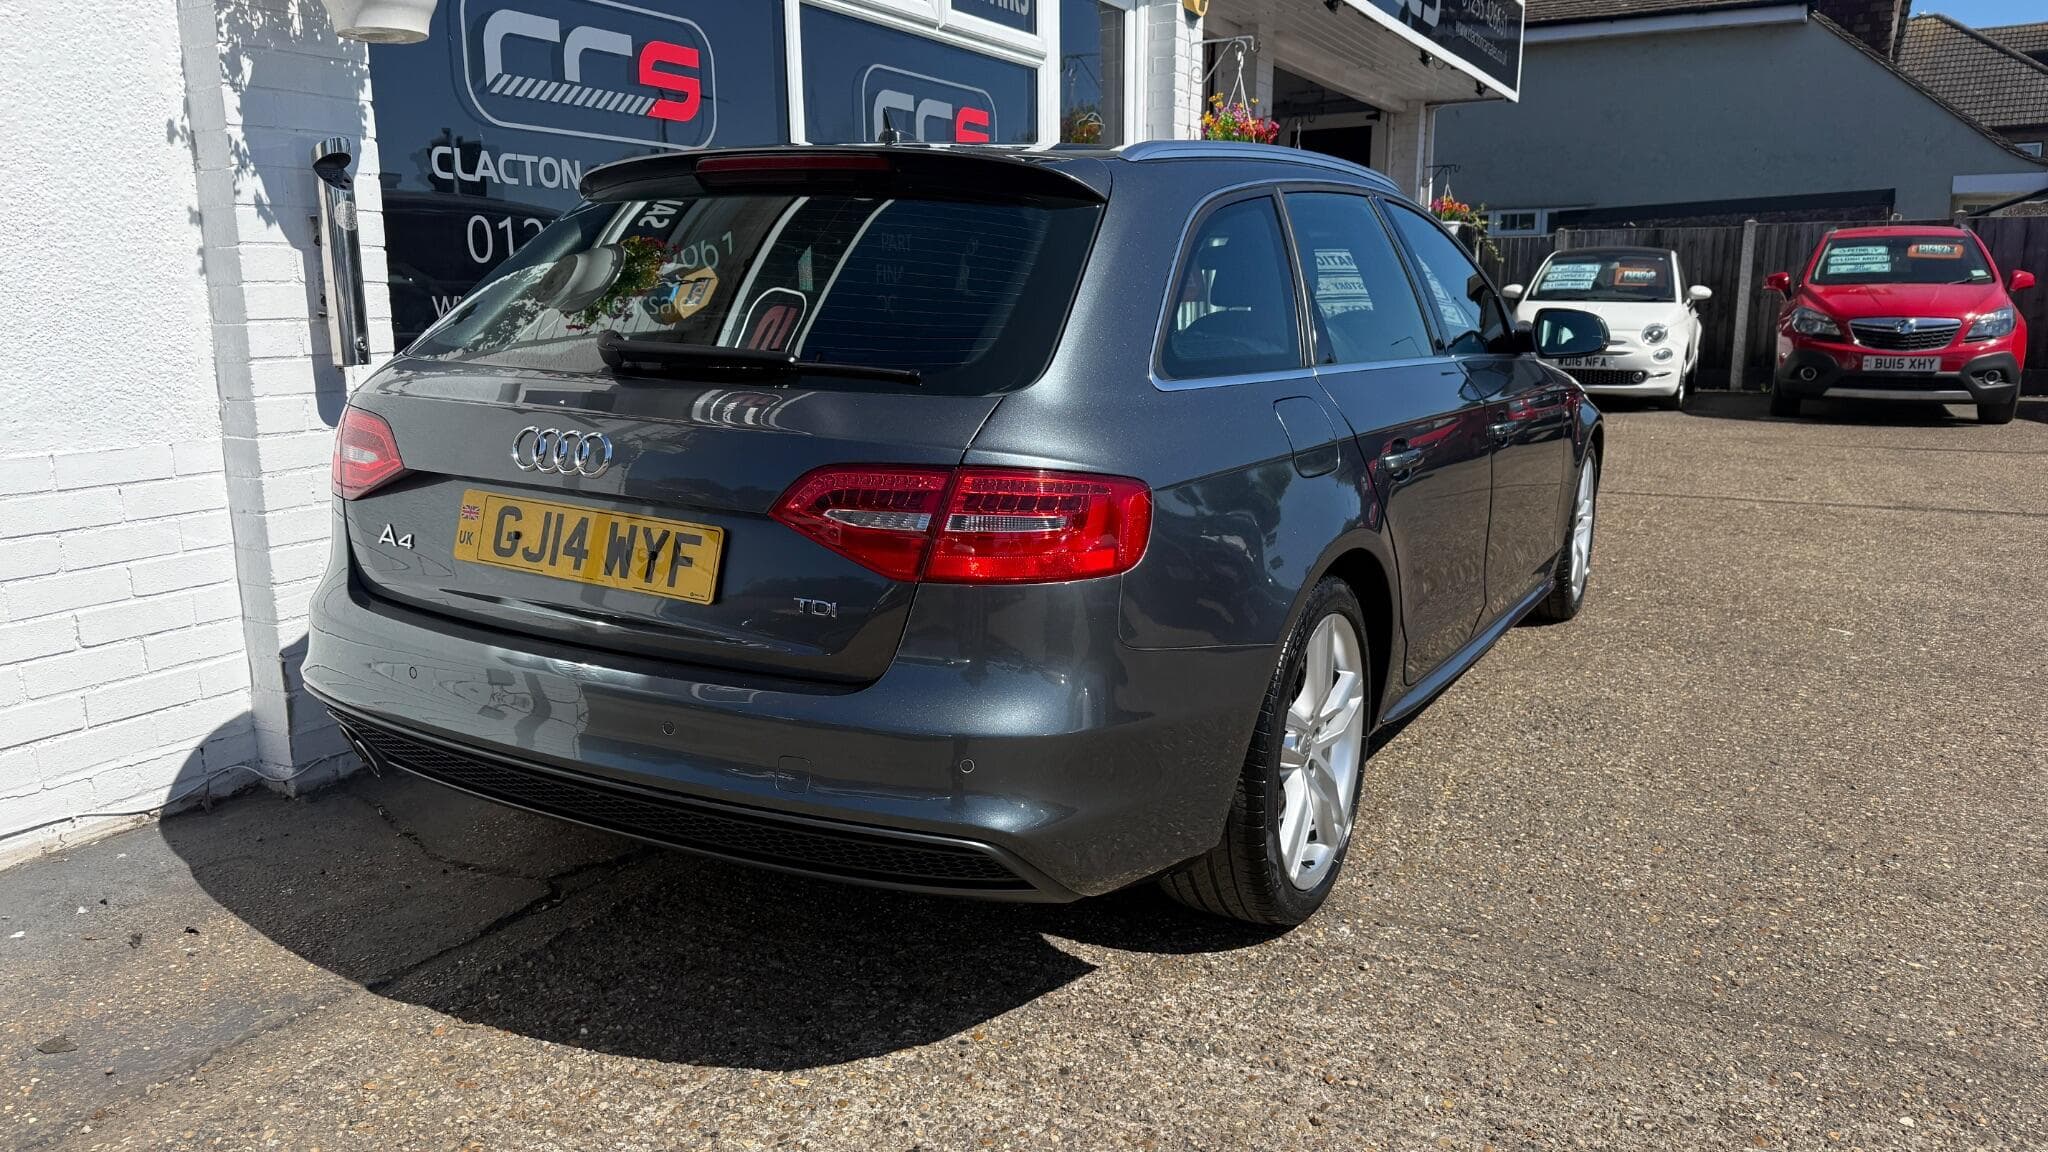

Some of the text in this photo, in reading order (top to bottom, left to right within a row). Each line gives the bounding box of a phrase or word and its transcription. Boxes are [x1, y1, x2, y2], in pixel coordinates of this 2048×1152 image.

[431, 146, 581, 190] CLACTON
[1585, 356, 1606, 367] NFA
[1874, 358, 1936, 369] BU15 XHY
[378, 523, 415, 549] A4
[459, 531, 473, 546] UK
[492, 505, 703, 588] GJ14 WYF
[793, 597, 837, 618] TDI
